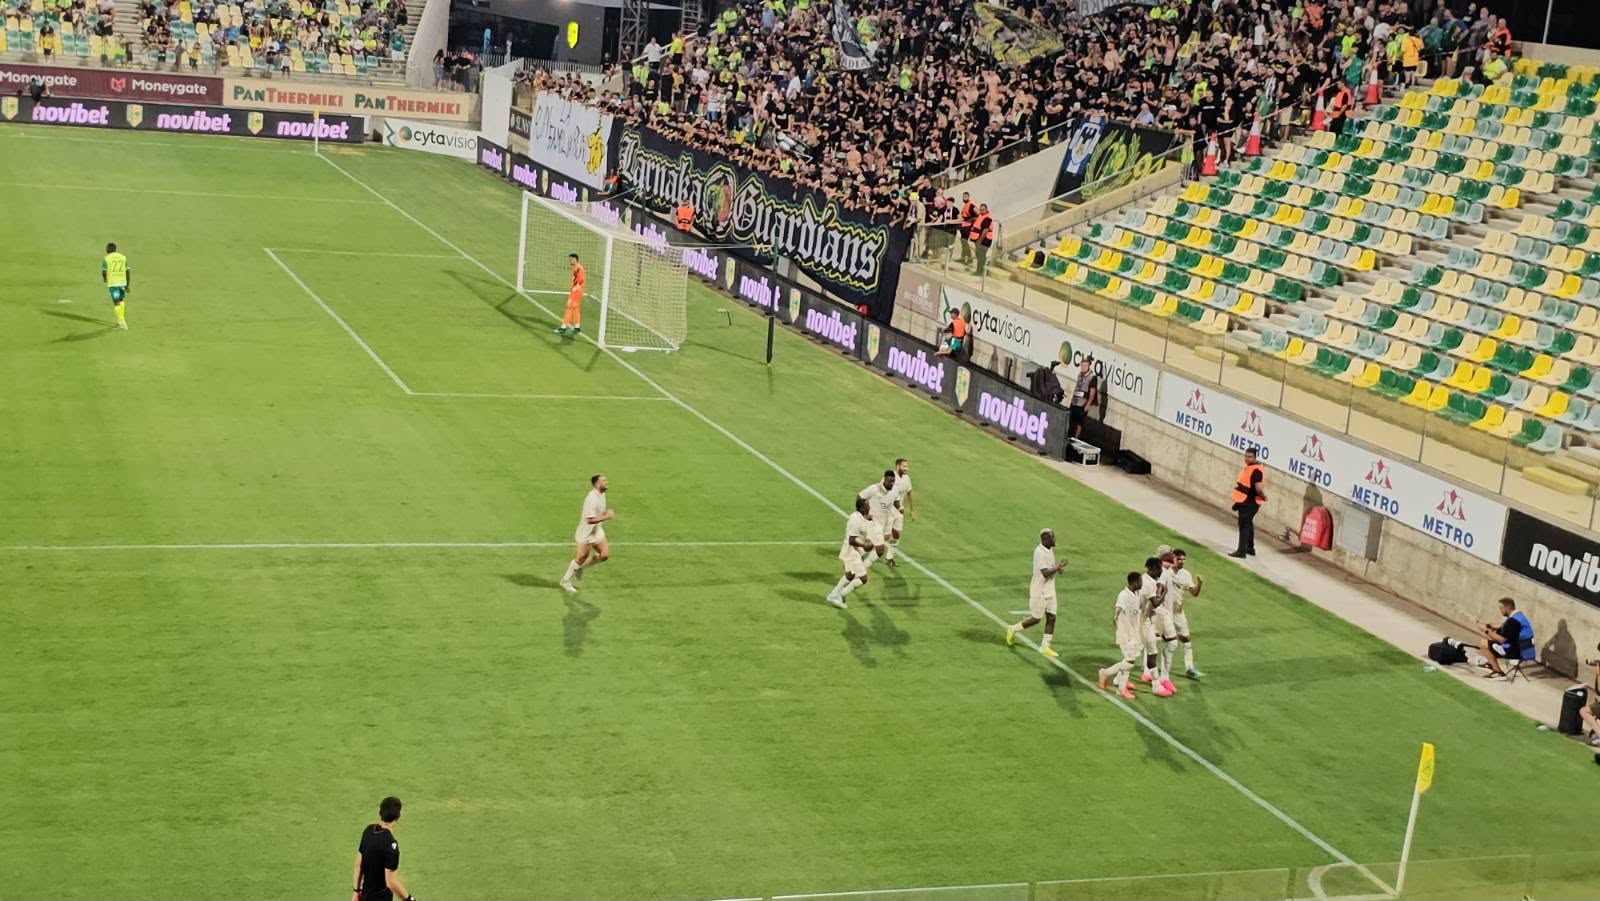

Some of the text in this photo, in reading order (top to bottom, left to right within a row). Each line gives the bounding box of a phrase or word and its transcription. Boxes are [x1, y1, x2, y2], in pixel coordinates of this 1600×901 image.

[132, 79, 207, 95] Moneygate
[32, 103, 109, 125] novibet
[157, 111, 231, 132] novibet
[277, 119, 349, 139] novibet
[413, 131, 477, 151] cytavisio
[112, 260, 125, 273] 22
[740, 275, 780, 312] novibt
[806, 308, 857, 350] novibet
[972, 308, 1031, 348] cytavision
[887, 346, 944, 393] novibet
[978, 391, 1049, 445] novibet
[1176, 410, 1212, 436] METRO
[1230, 433, 1269, 460] METRO
[1289, 458, 1332, 487] METRO
[1352, 484, 1399, 515] METRO
[1423, 514, 1474, 548] METRO
[1529, 543, 1600, 592] novib
